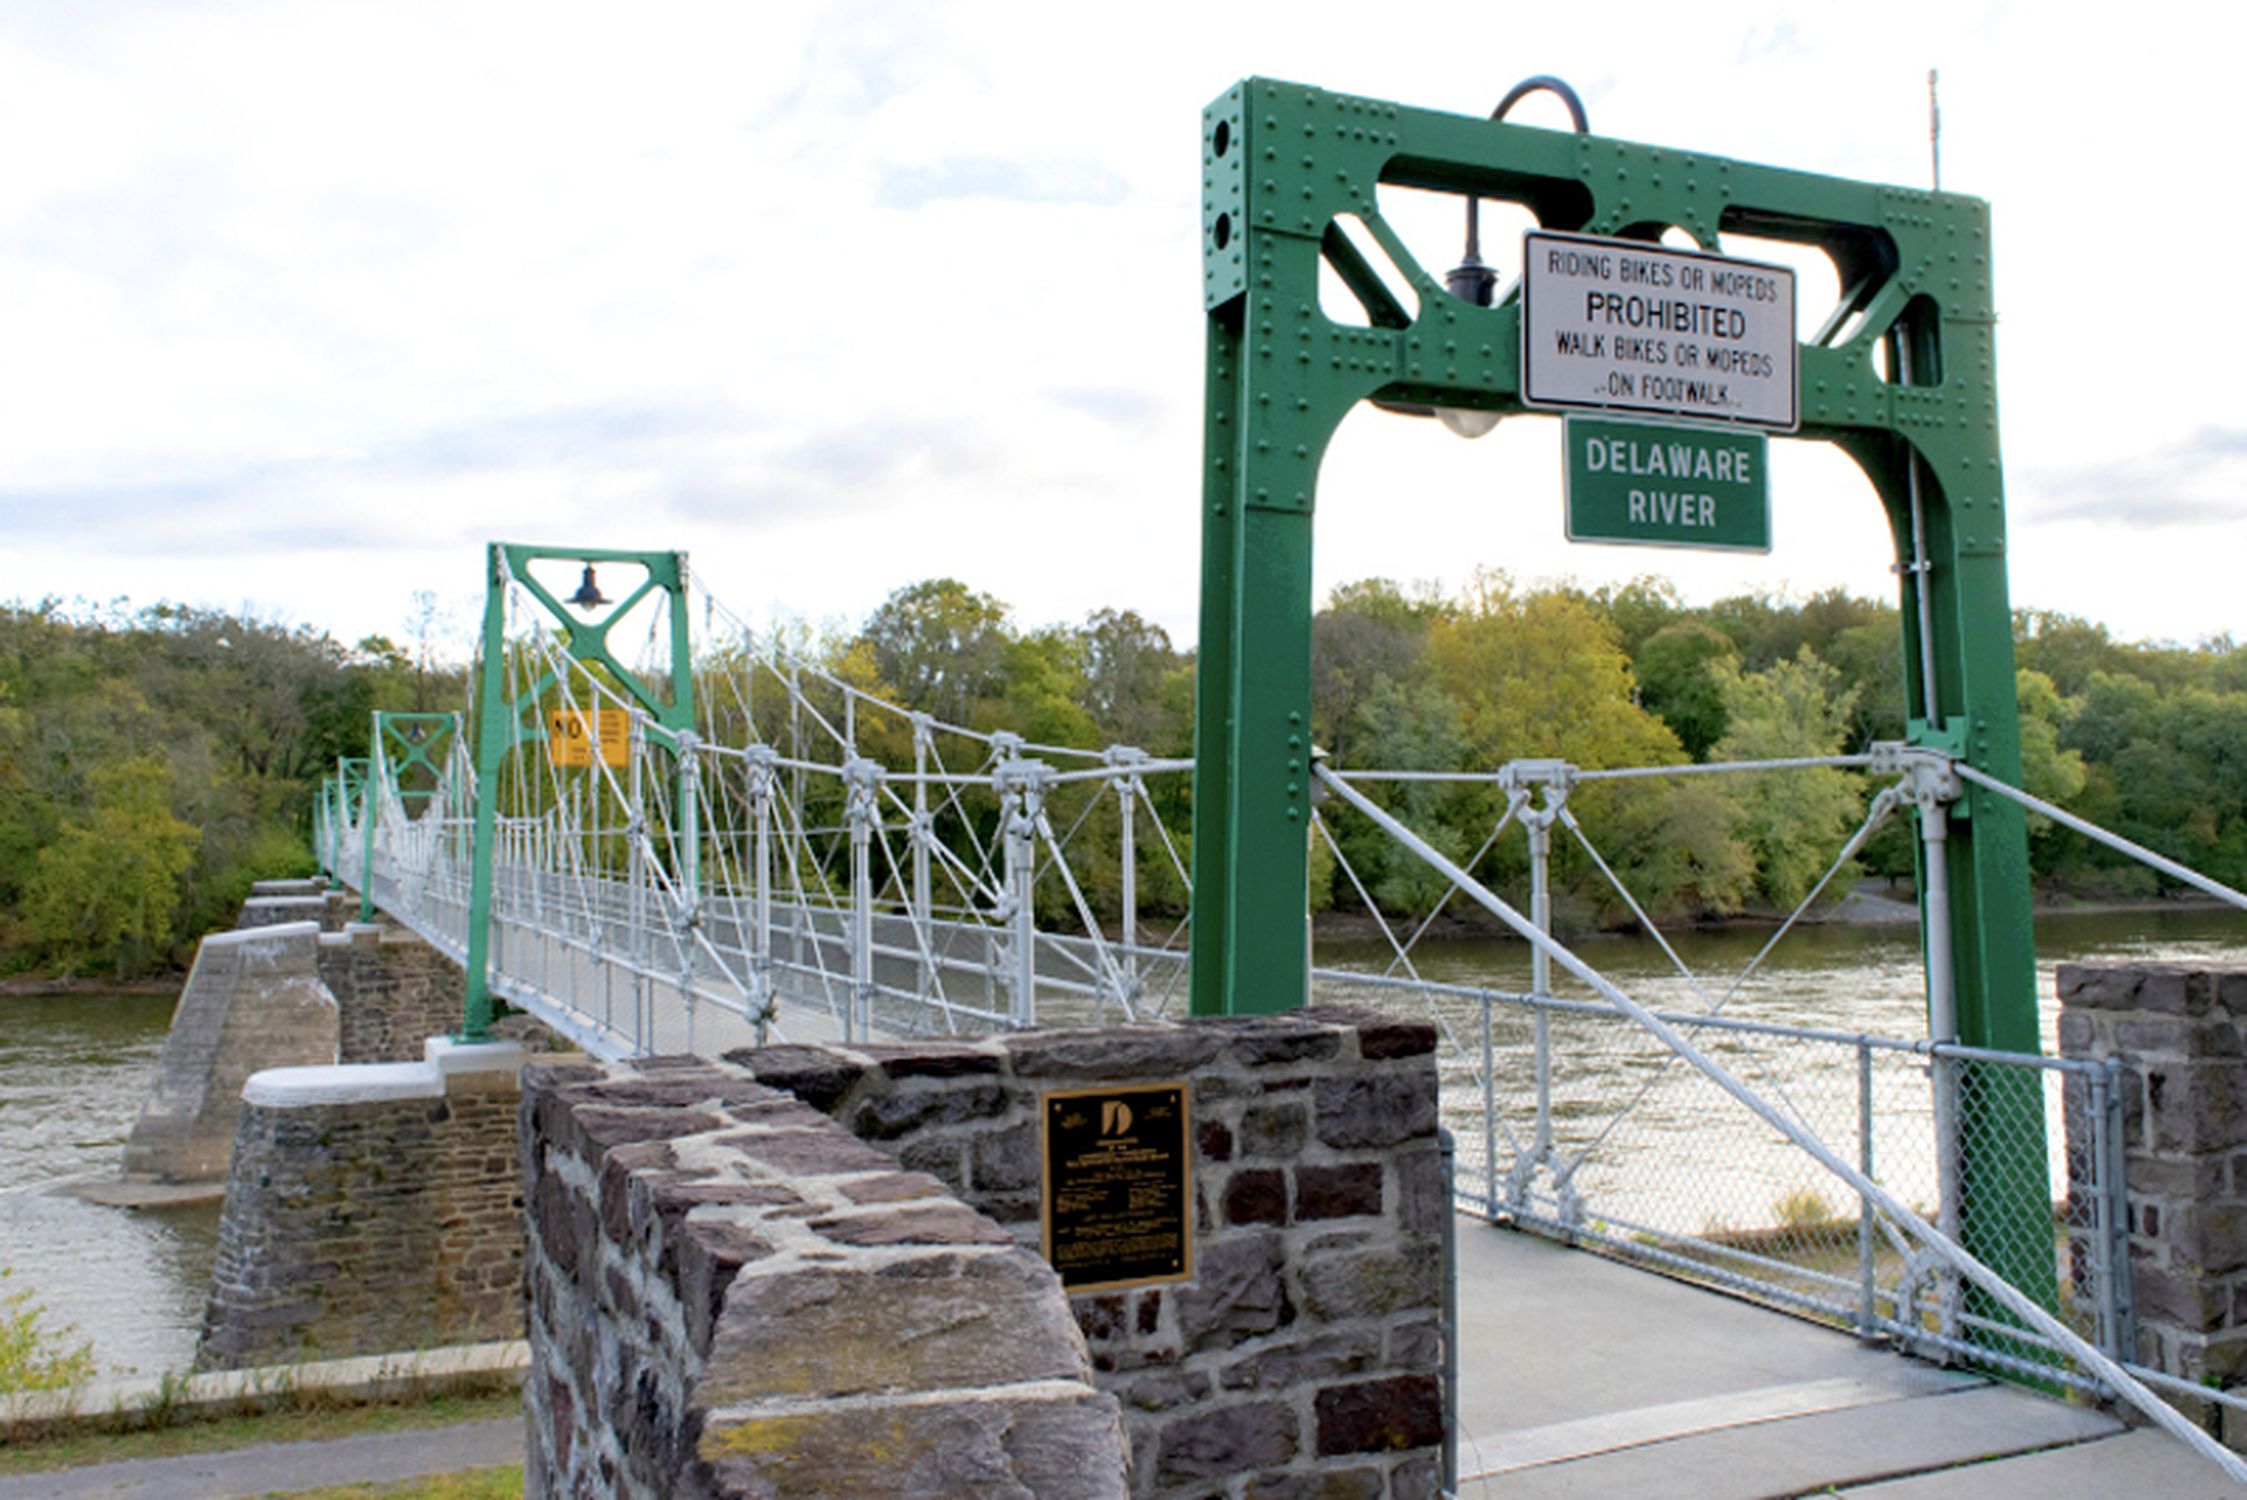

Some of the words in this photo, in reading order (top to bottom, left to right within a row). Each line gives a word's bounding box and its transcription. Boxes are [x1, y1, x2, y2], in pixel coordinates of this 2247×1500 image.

[1548, 249, 1611, 280] RIDING
[1620, 257, 1673, 287] BIKES
[1681, 265, 1704, 292] OR
[1710, 270, 1777, 303] MOPEDS
[1586, 290, 1746, 340] PROHIBITED
[1555, 330, 1605, 357] WALK
[1614, 335, 1668, 364] BIKES
[1675, 342, 1699, 368] OR
[1705, 347, 1774, 378] MOPEDS
[1586, 437, 1750, 483] DELAWARE
[1628, 489, 1716, 527] RIVER
